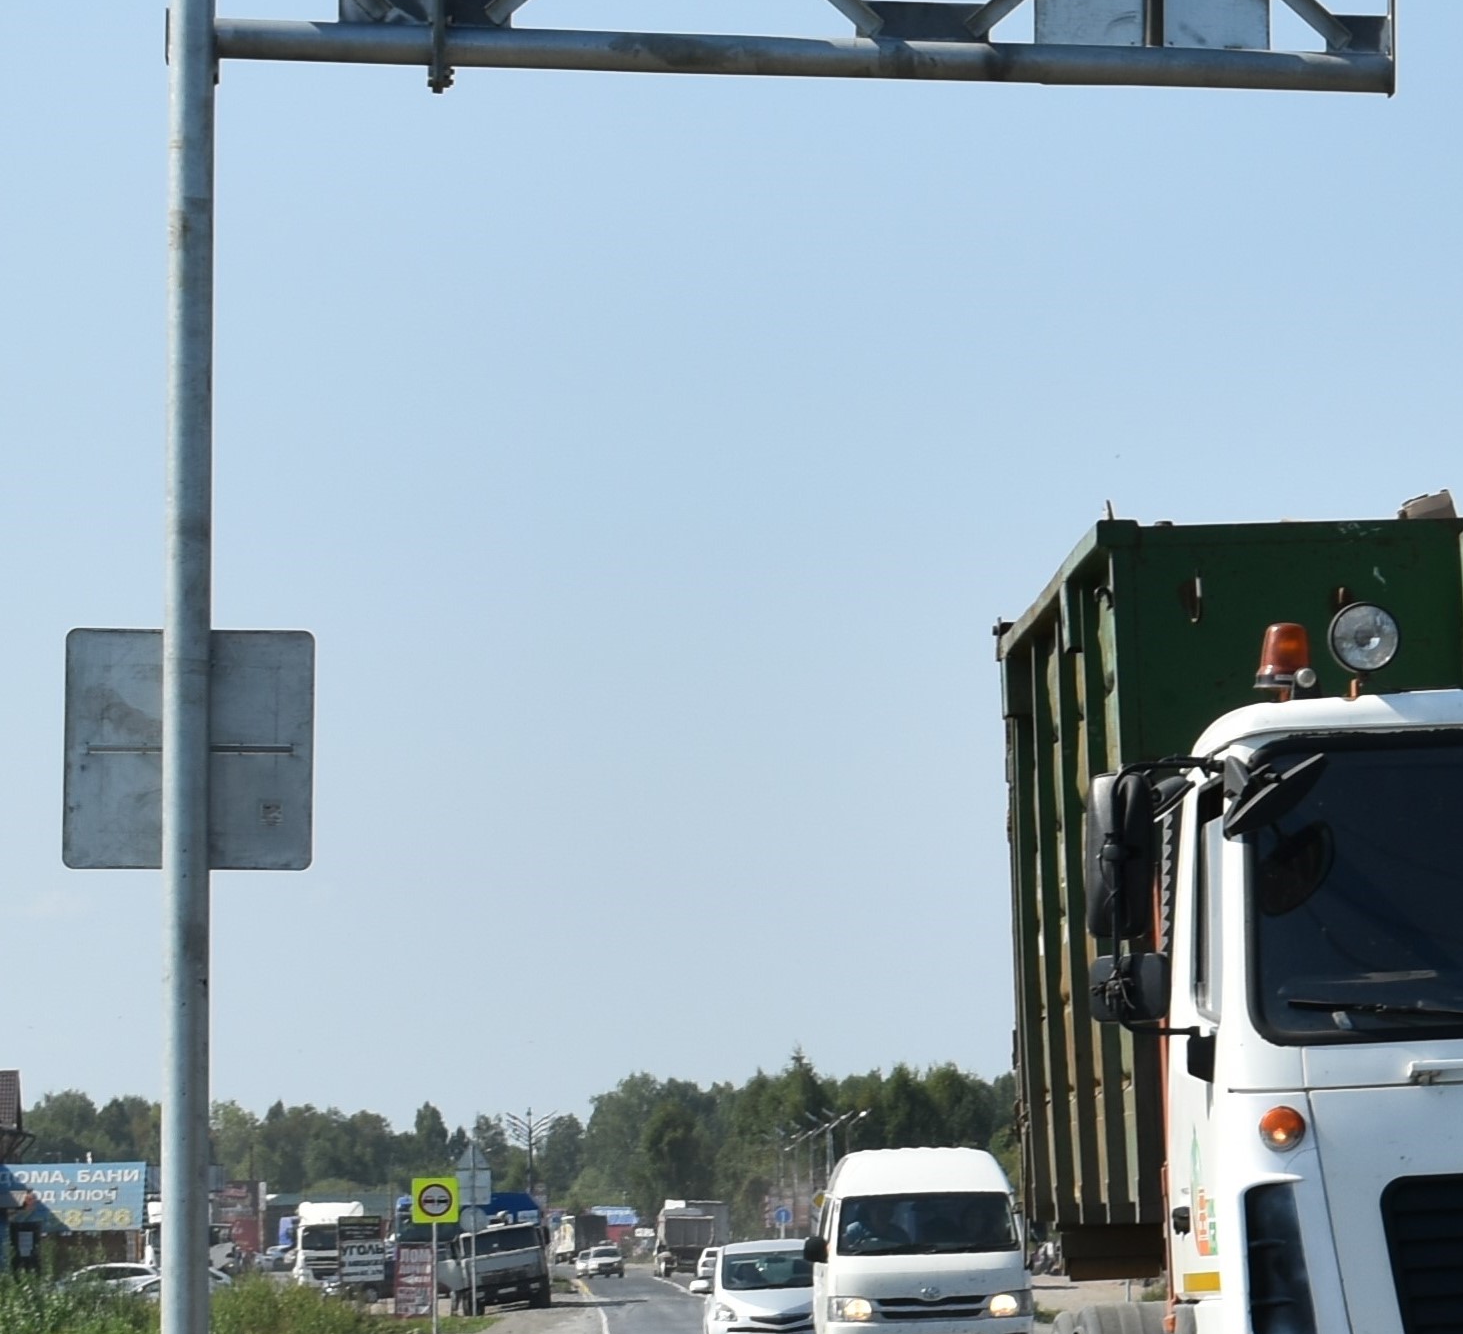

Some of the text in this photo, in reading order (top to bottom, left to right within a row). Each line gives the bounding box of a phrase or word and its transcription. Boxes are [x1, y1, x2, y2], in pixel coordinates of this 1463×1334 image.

[77, 1169, 140, 1183] БАНИ
[60, 1189, 117, 1202] КЛЮЧ
[341, 1243, 384, 1256] УГОЛЬ
